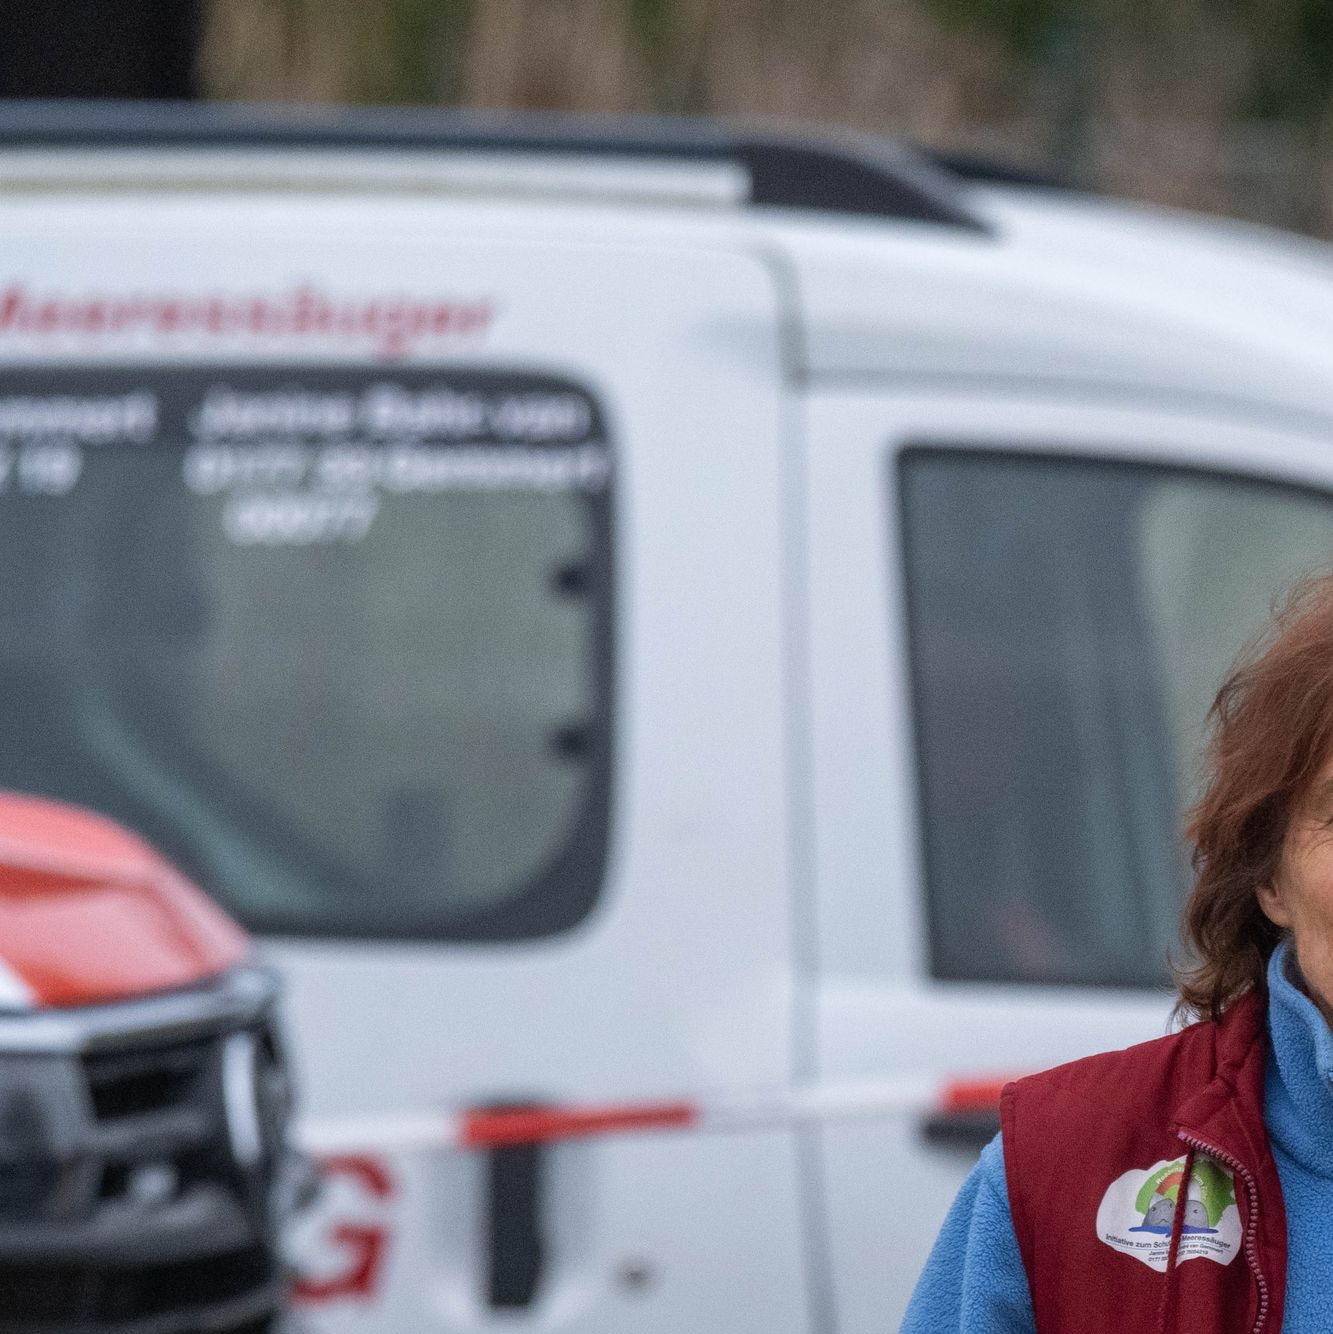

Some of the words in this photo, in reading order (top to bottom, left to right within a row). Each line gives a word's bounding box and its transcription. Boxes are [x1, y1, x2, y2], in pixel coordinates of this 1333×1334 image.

[1105, 1233, 1134, 1248] Initiative
[1135, 1241, 1152, 1249] zum
[1182, 1234, 1231, 1249] Meeressäuger
